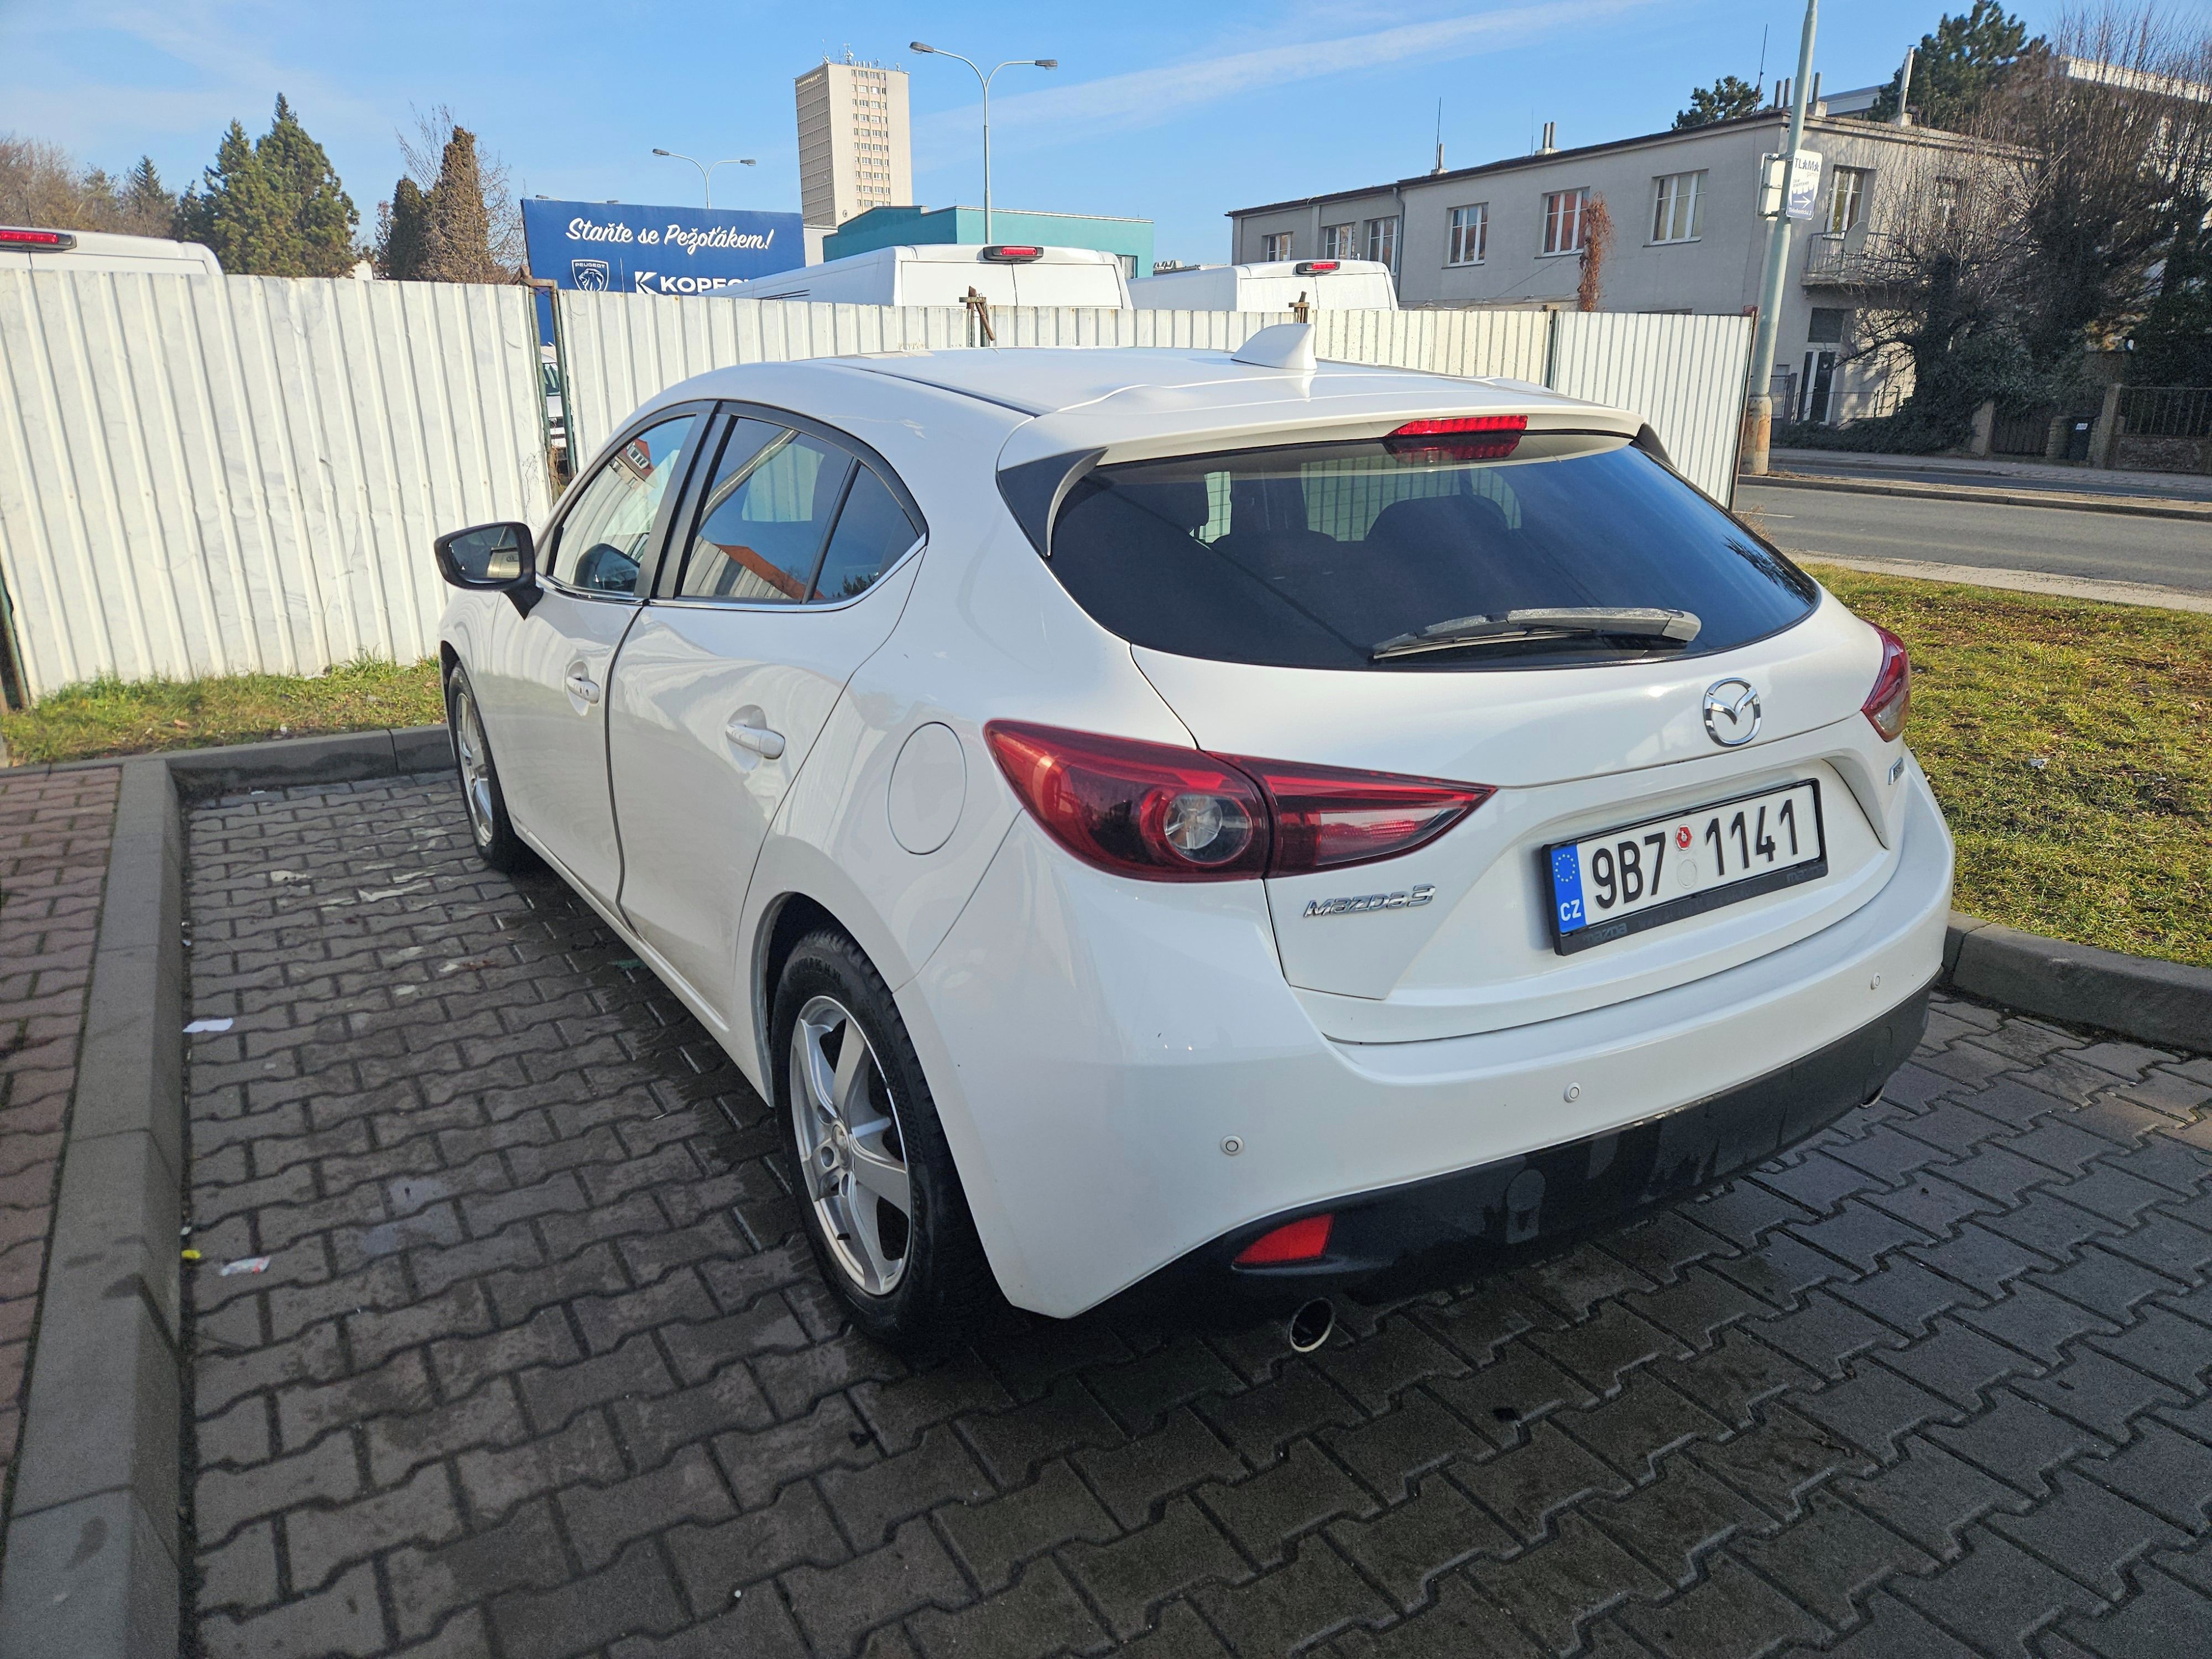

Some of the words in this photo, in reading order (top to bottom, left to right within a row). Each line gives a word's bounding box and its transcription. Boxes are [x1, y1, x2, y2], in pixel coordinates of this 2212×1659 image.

[565, 217, 633, 243] Staňte
[637, 228, 660, 244] se
[664, 223, 775, 255] Pežoťákem!
[660, 276, 749, 293] KOPE
[1592, 832, 1666, 909] 9B7
[1705, 799, 1798, 877] 1141
[1560, 899, 1582, 921] CZ
